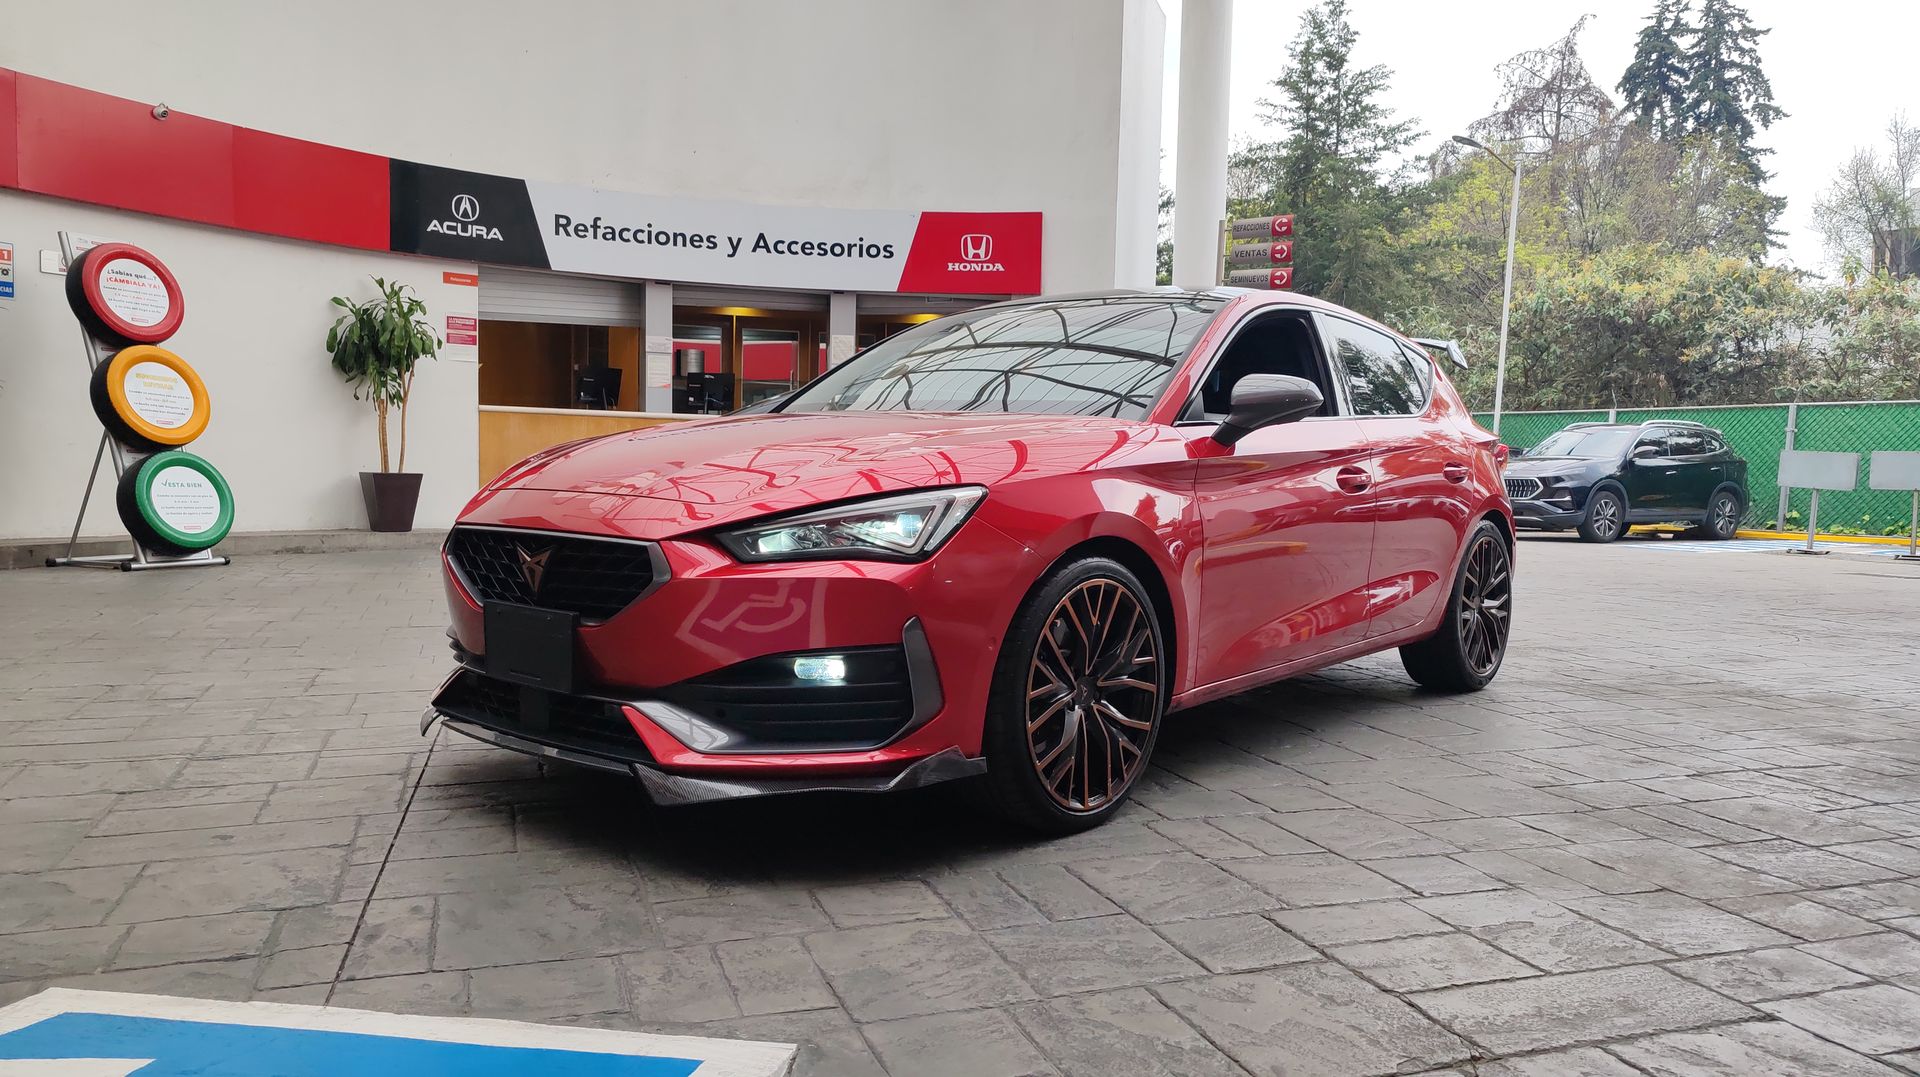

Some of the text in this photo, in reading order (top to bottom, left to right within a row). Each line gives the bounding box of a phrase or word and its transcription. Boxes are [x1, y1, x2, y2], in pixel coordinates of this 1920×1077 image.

[426, 219, 504, 241] ACURA
[1233, 222, 1270, 233] REFACCIONES
[554, 213, 895, 259] Refacciones y Accesorios
[1234, 248, 1268, 258] VENTAS
[947, 262, 1005, 272] HONDA
[1230, 274, 1269, 284] SEMINUEVOS
